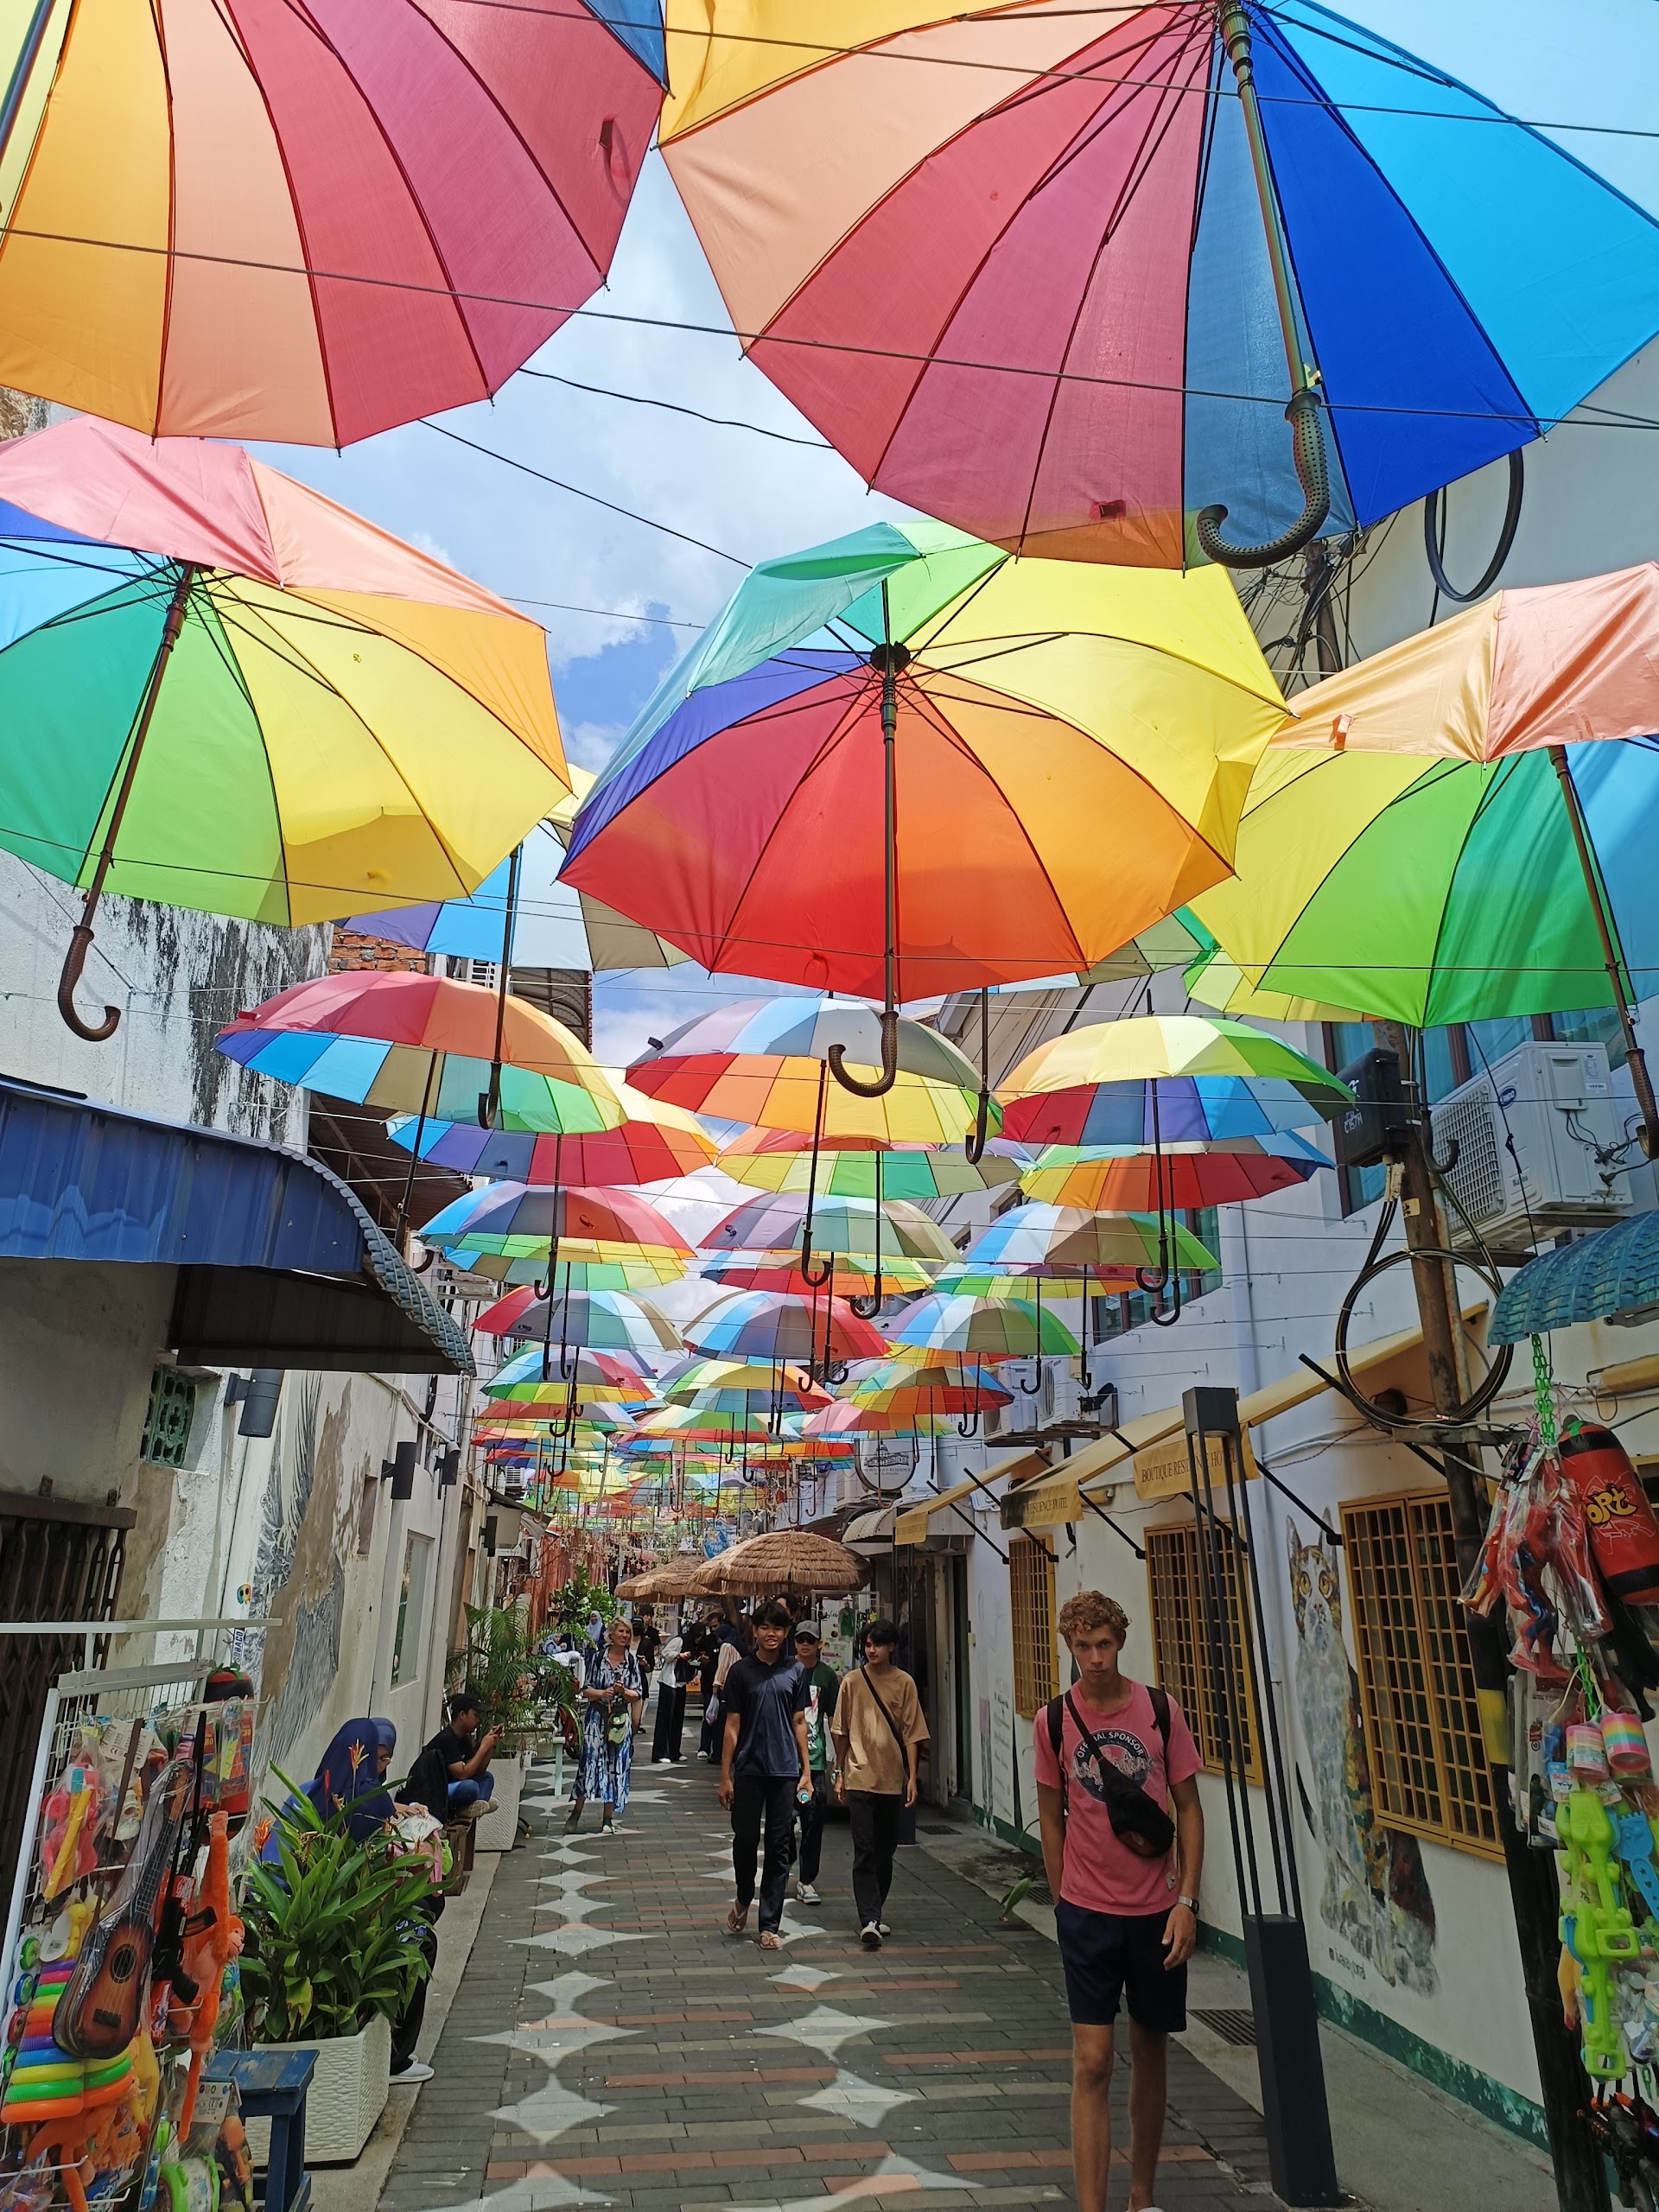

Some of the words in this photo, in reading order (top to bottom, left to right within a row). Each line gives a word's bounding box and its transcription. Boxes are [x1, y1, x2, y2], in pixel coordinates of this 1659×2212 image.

[1141, 1462, 1173, 1483] BOUTIQUE
[1052, 1497, 1069, 1510] HOTEL
[1077, 1732, 1107, 1758] OFFIAL
[1108, 1731, 1144, 1756] SPONSOR
